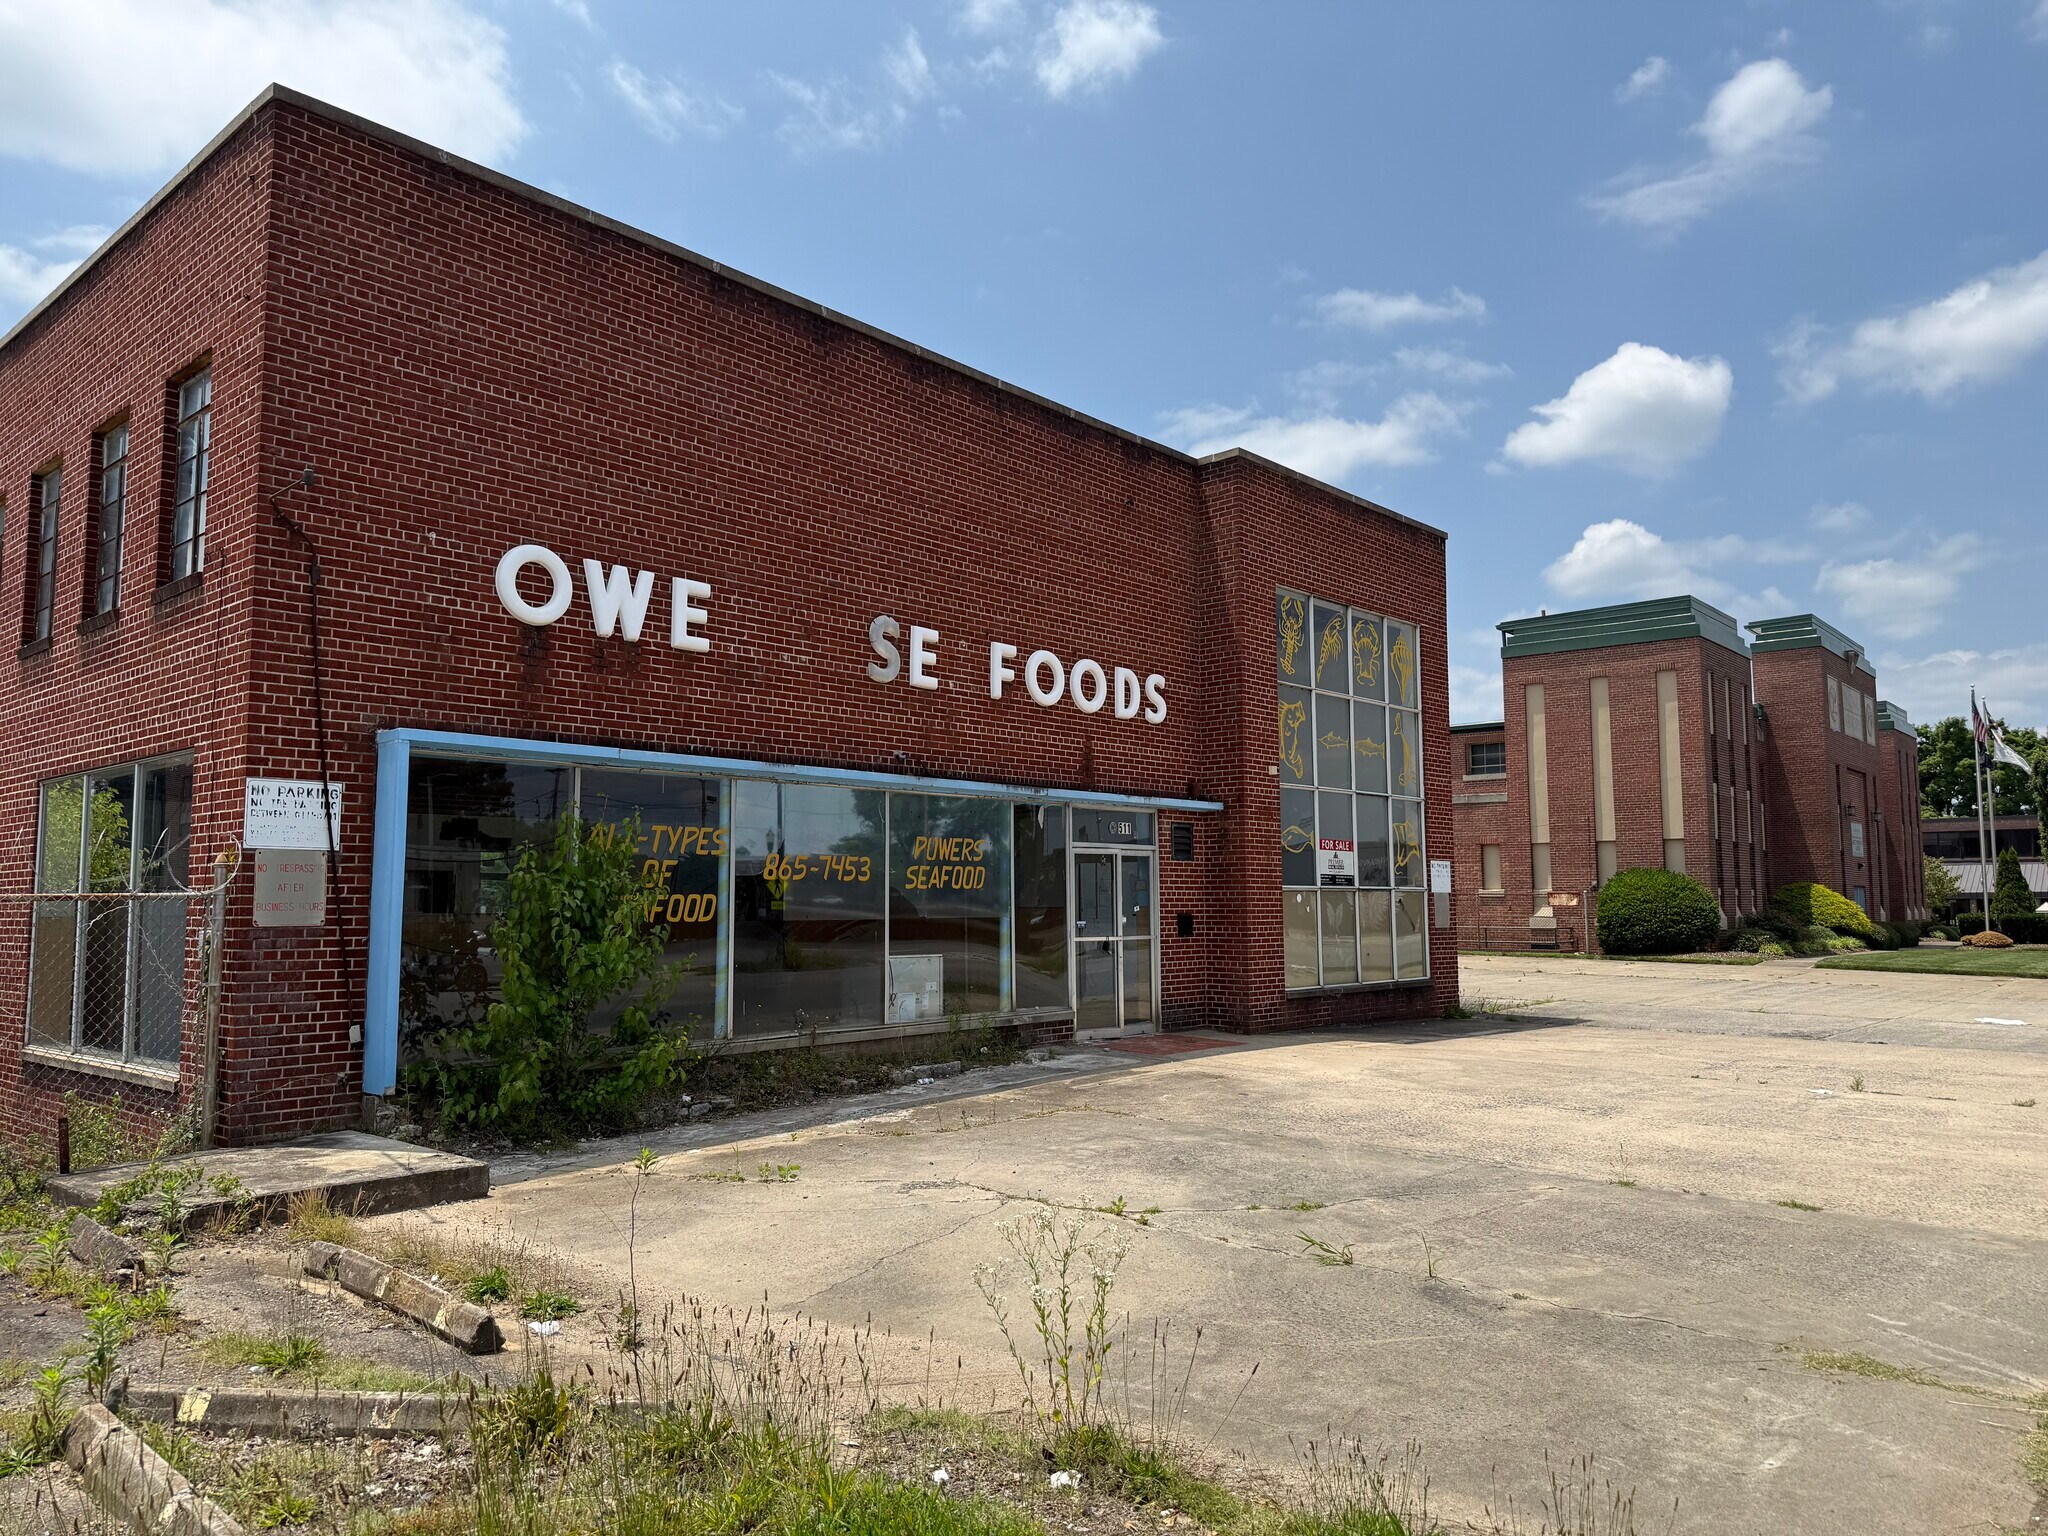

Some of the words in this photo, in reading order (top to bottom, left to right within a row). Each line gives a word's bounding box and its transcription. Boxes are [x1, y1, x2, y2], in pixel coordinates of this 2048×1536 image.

[495, 543, 712, 654] OWE
[867, 614, 939, 690] SE
[989, 641, 1168, 725] FOODS
[913, 836, 985, 862] POWERS
[1321, 840, 1334, 850] FOR
[1335, 841, 1350, 851] SALE
[257, 863, 267, 873] NO
[641, 859, 680, 888] OF
[763, 853, 871, 882] 865-7453
[905, 865, 986, 890] SEAFOOD
[277, 883, 304, 893] AFTER
[256, 902, 294, 912] BUSINESS
[299, 902, 324, 912] HOURS
[642, 893, 717, 923] FOOD
